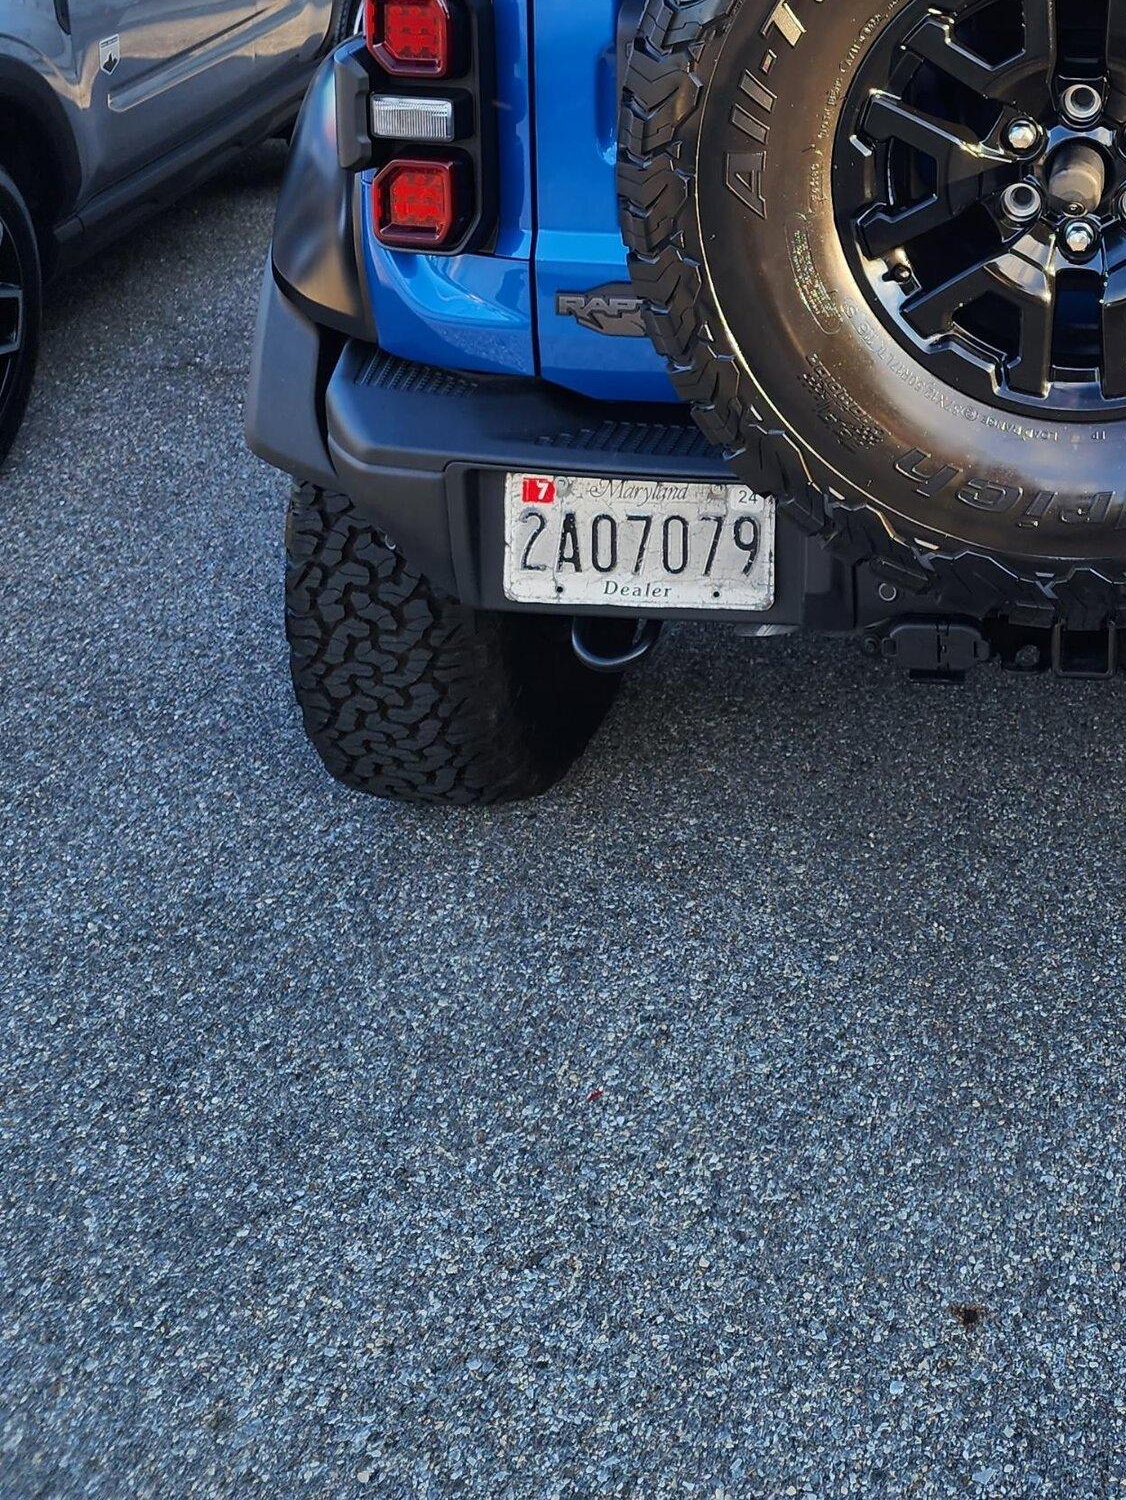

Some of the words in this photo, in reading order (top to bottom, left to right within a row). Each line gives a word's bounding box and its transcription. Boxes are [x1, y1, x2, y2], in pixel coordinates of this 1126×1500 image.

[557, 295, 643, 330] RAP
[536, 482, 550, 500] 7
[589, 479, 691, 508] Maryland
[738, 489, 759, 505] 24
[520, 508, 760, 577] 2A07079
[603, 580, 673, 599] Dealer
